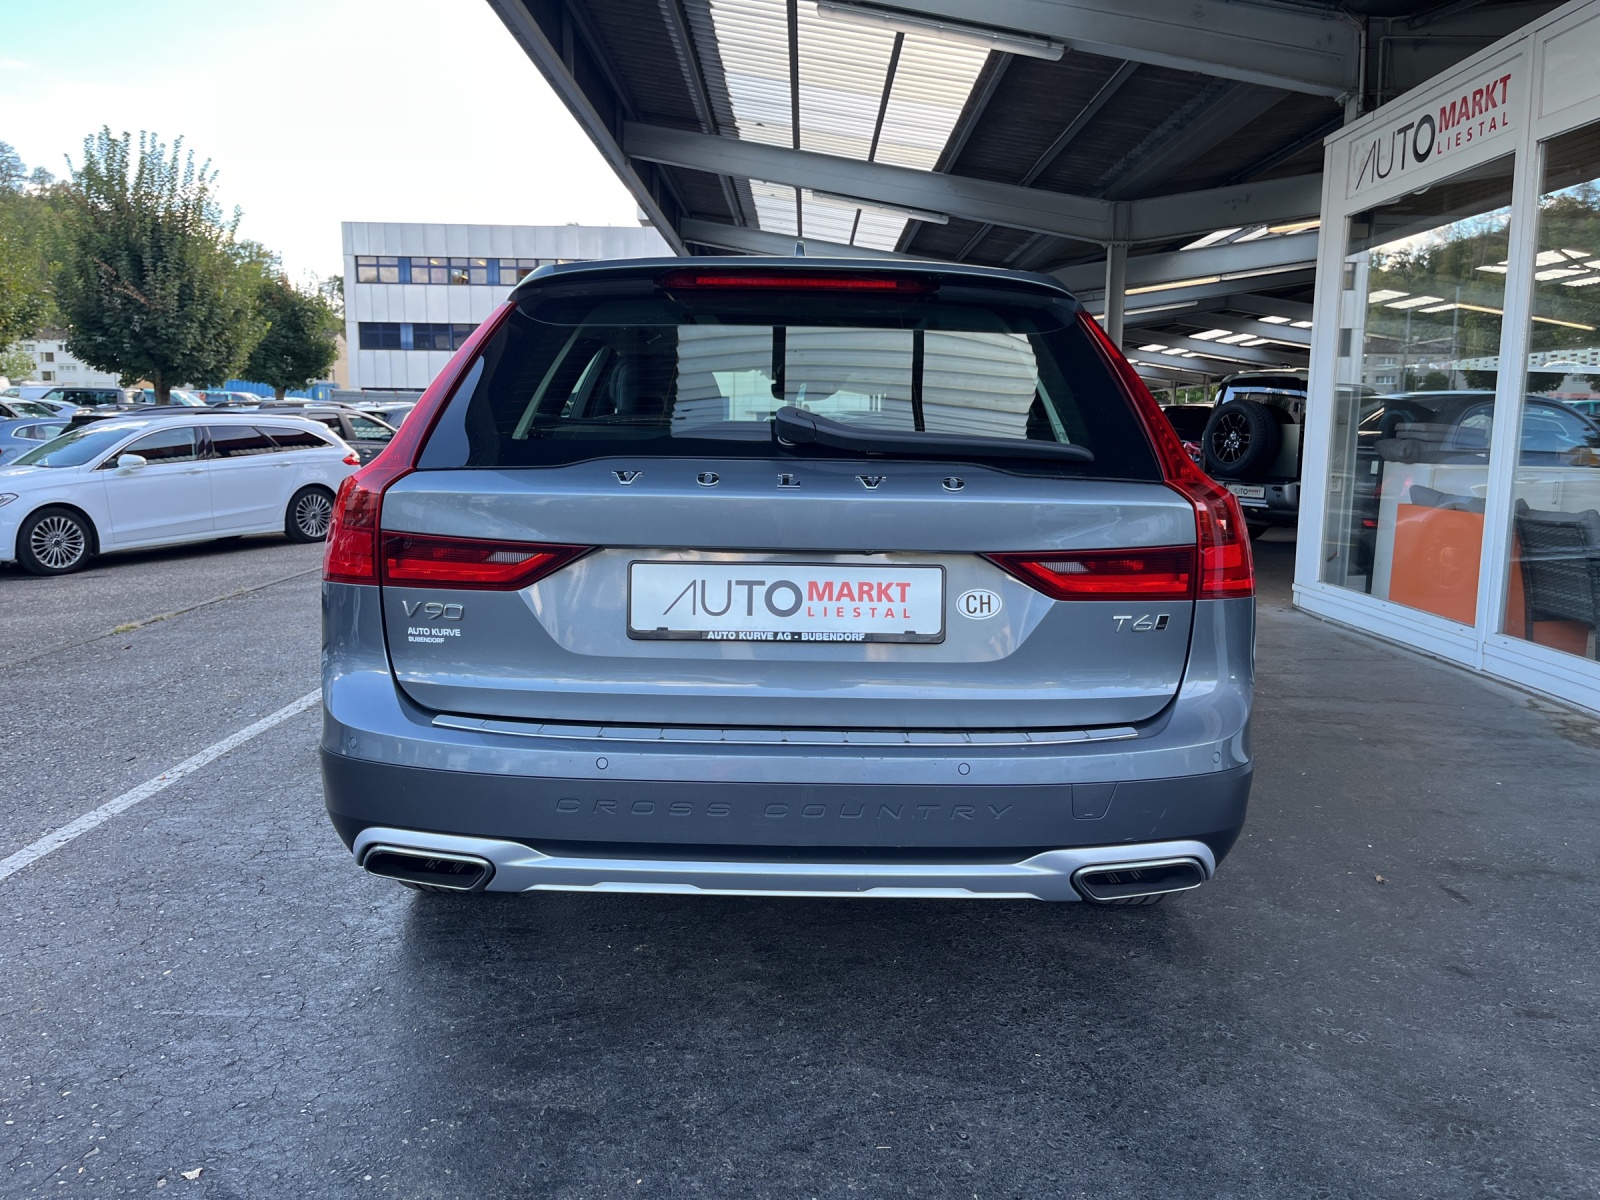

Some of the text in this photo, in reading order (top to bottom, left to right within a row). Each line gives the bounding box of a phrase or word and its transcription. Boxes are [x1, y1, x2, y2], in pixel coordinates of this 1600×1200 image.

[1355, 73, 1512, 190] AUTO MARKT
[1437, 111, 1509, 155] LIESTAL
[611, 470, 966, 491] VOLVO
[662, 579, 912, 618] AUTO MARKT
[964, 592, 992, 614] CH
[401, 600, 465, 621] V90
[807, 605, 911, 619] LIESTAL
[407, 627, 461, 637] AUTO KURVE
[707, 631, 735, 640] AUTO
[738, 631, 774, 641] KURVE
[776, 632, 792, 641] AG
[801, 632, 866, 642] BUBENDORF
[556, 797, 1013, 820] CROSS COUNTRY
